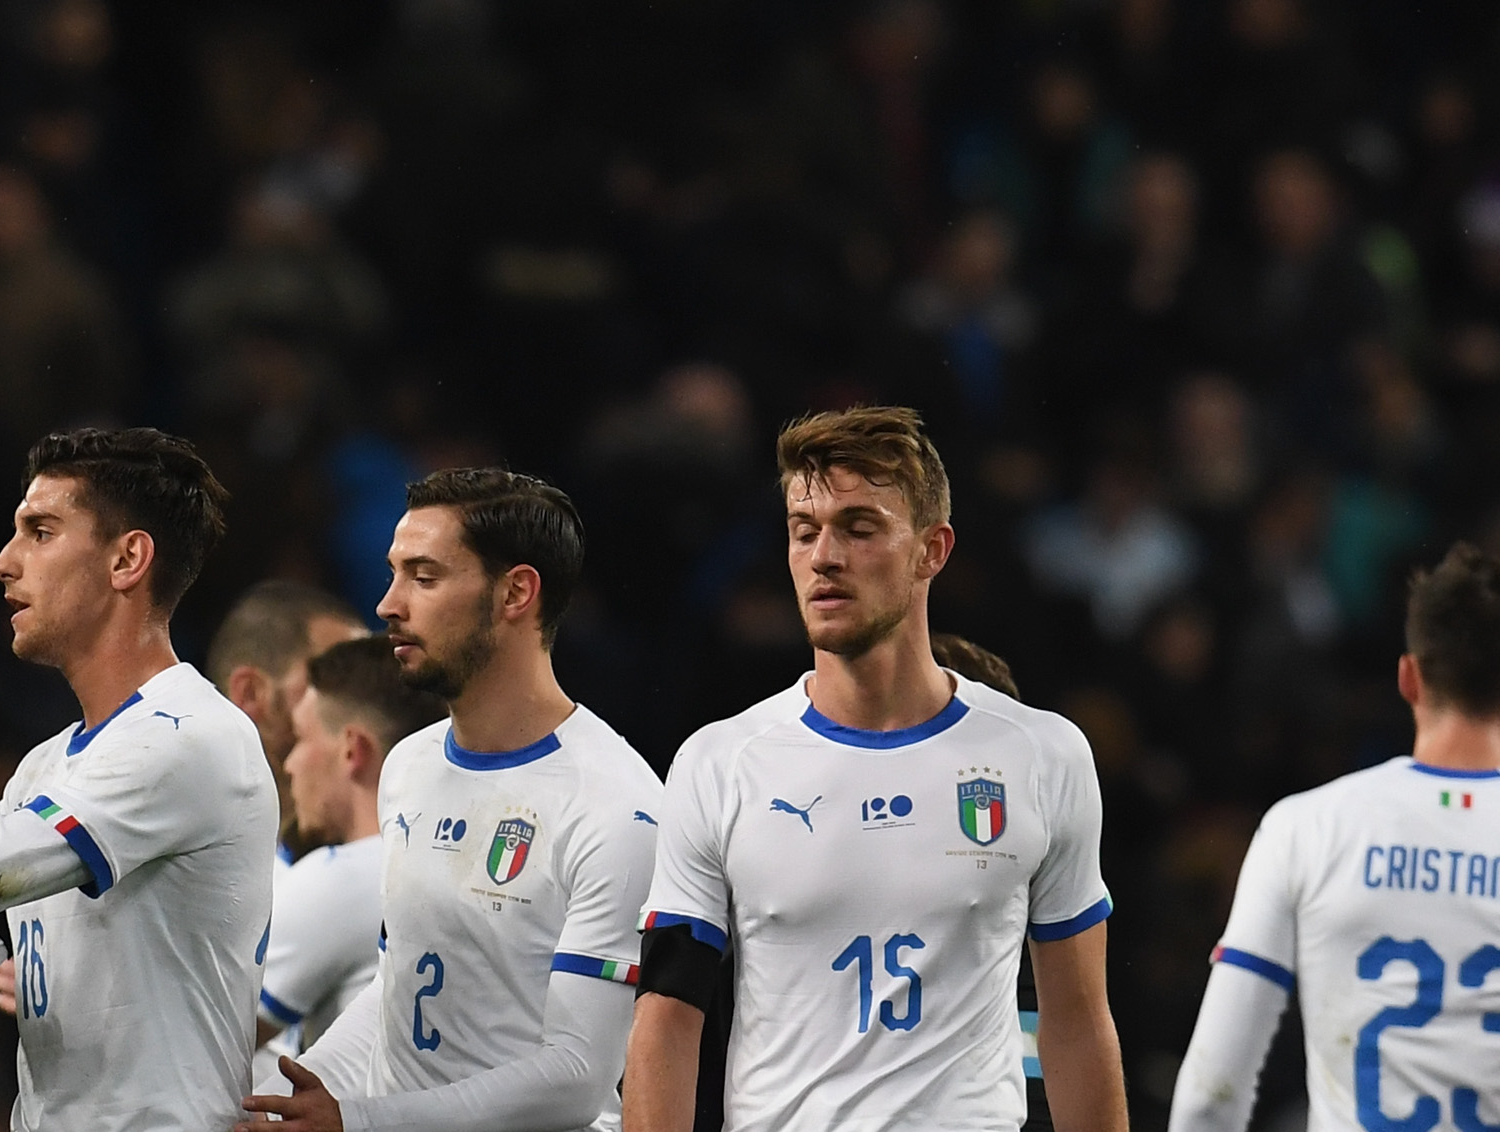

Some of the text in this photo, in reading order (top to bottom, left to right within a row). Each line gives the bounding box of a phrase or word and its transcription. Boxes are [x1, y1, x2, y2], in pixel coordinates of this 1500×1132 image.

[961, 783, 1002, 796] ITALIA
[498, 822, 533, 839] ITALIA
[491, 901, 502, 912] 13
[17, 917, 48, 1020] 16
[831, 933, 926, 1034] 15
[412, 951, 444, 1052] 2
